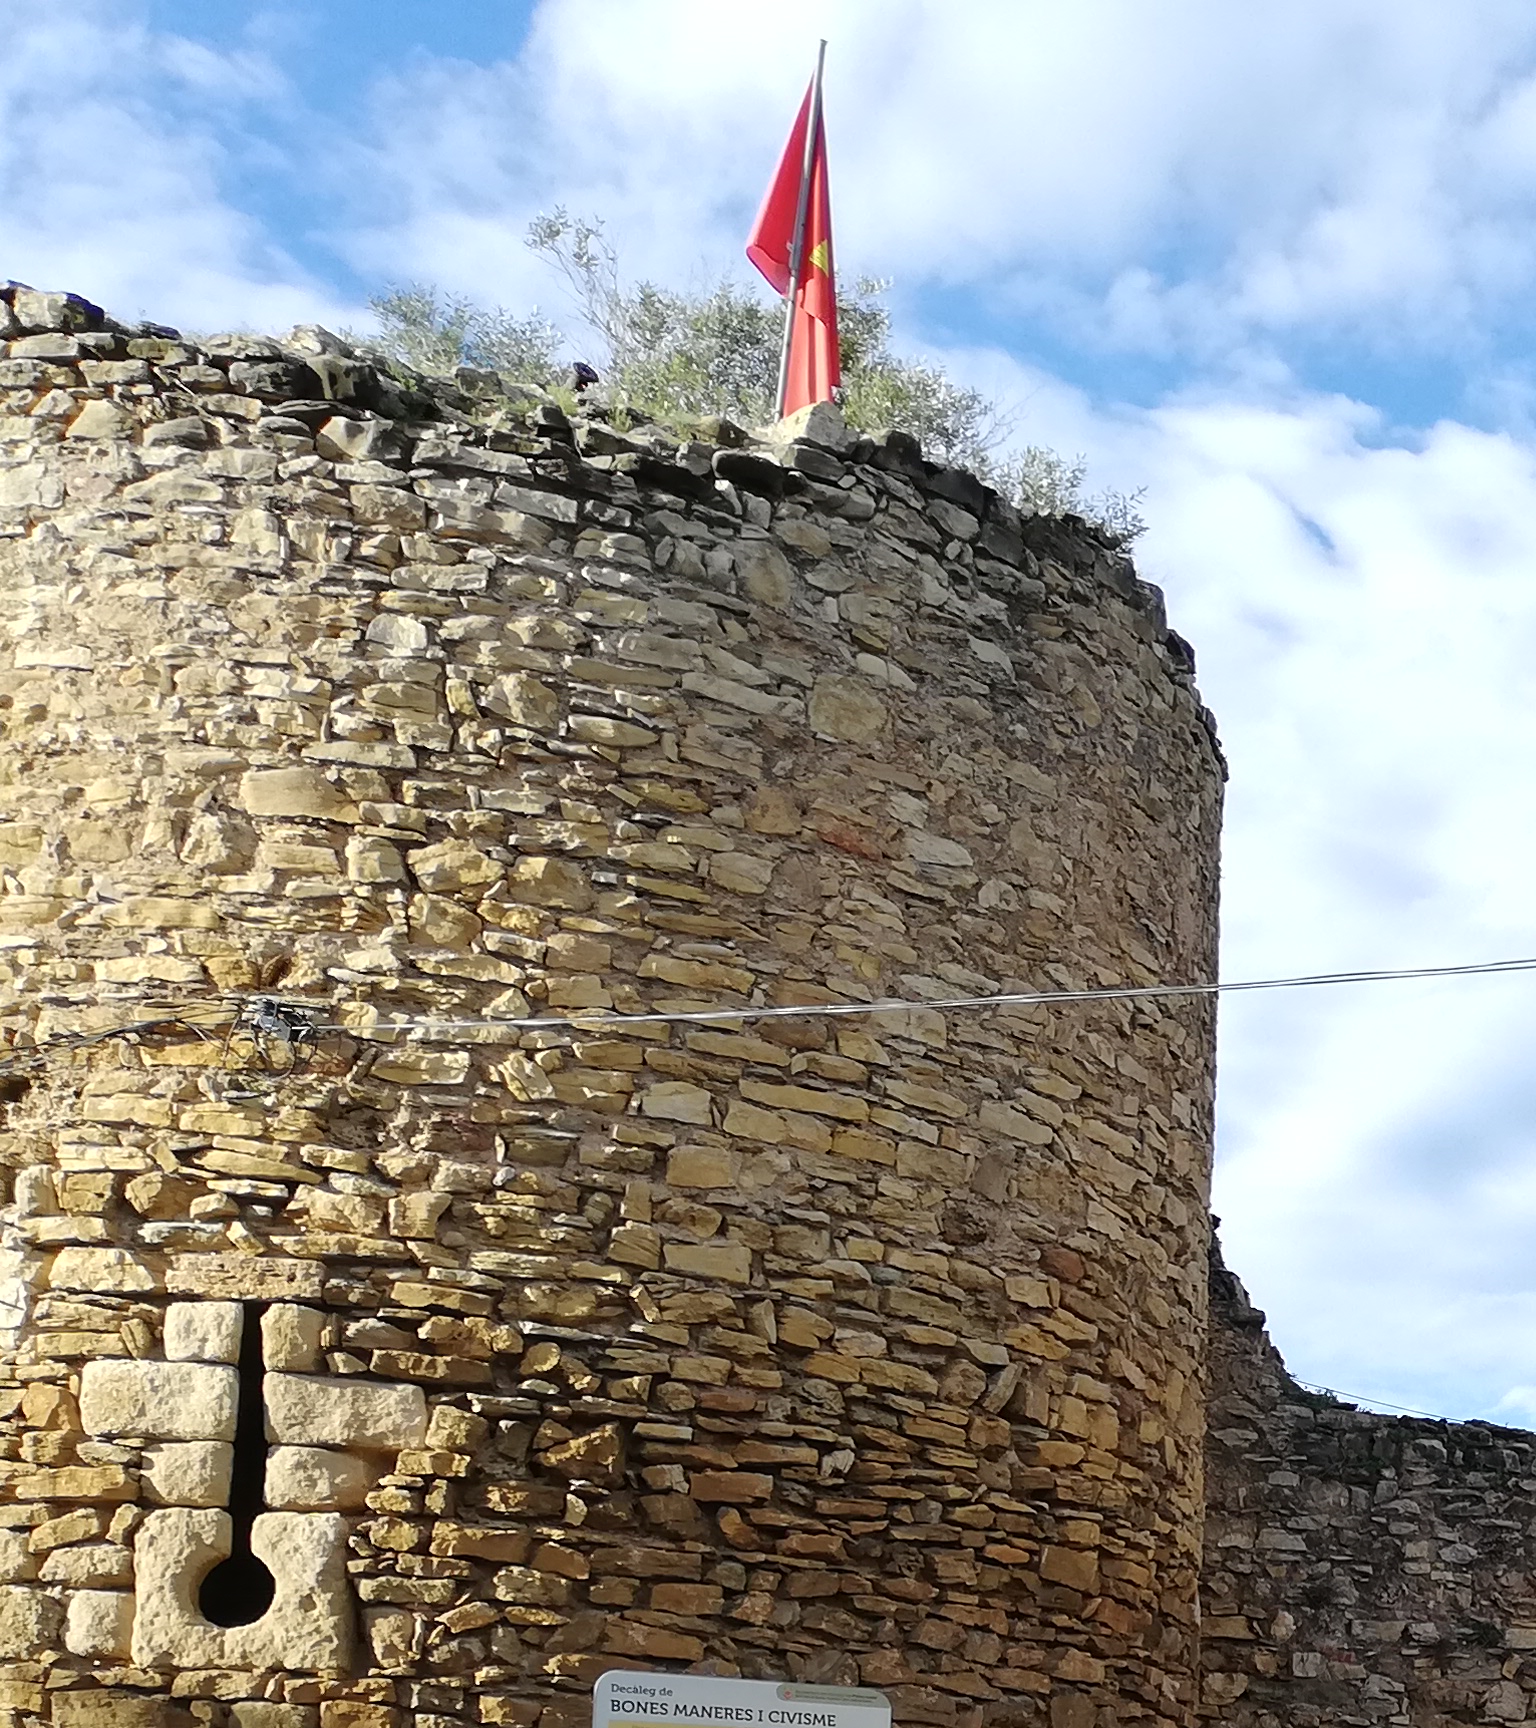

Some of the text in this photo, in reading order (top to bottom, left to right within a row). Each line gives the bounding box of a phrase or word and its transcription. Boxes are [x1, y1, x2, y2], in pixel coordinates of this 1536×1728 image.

[610, 1683, 673, 1698] Decàleg de
[610, 1699, 836, 1727] BONES MANERES I CIVISME
